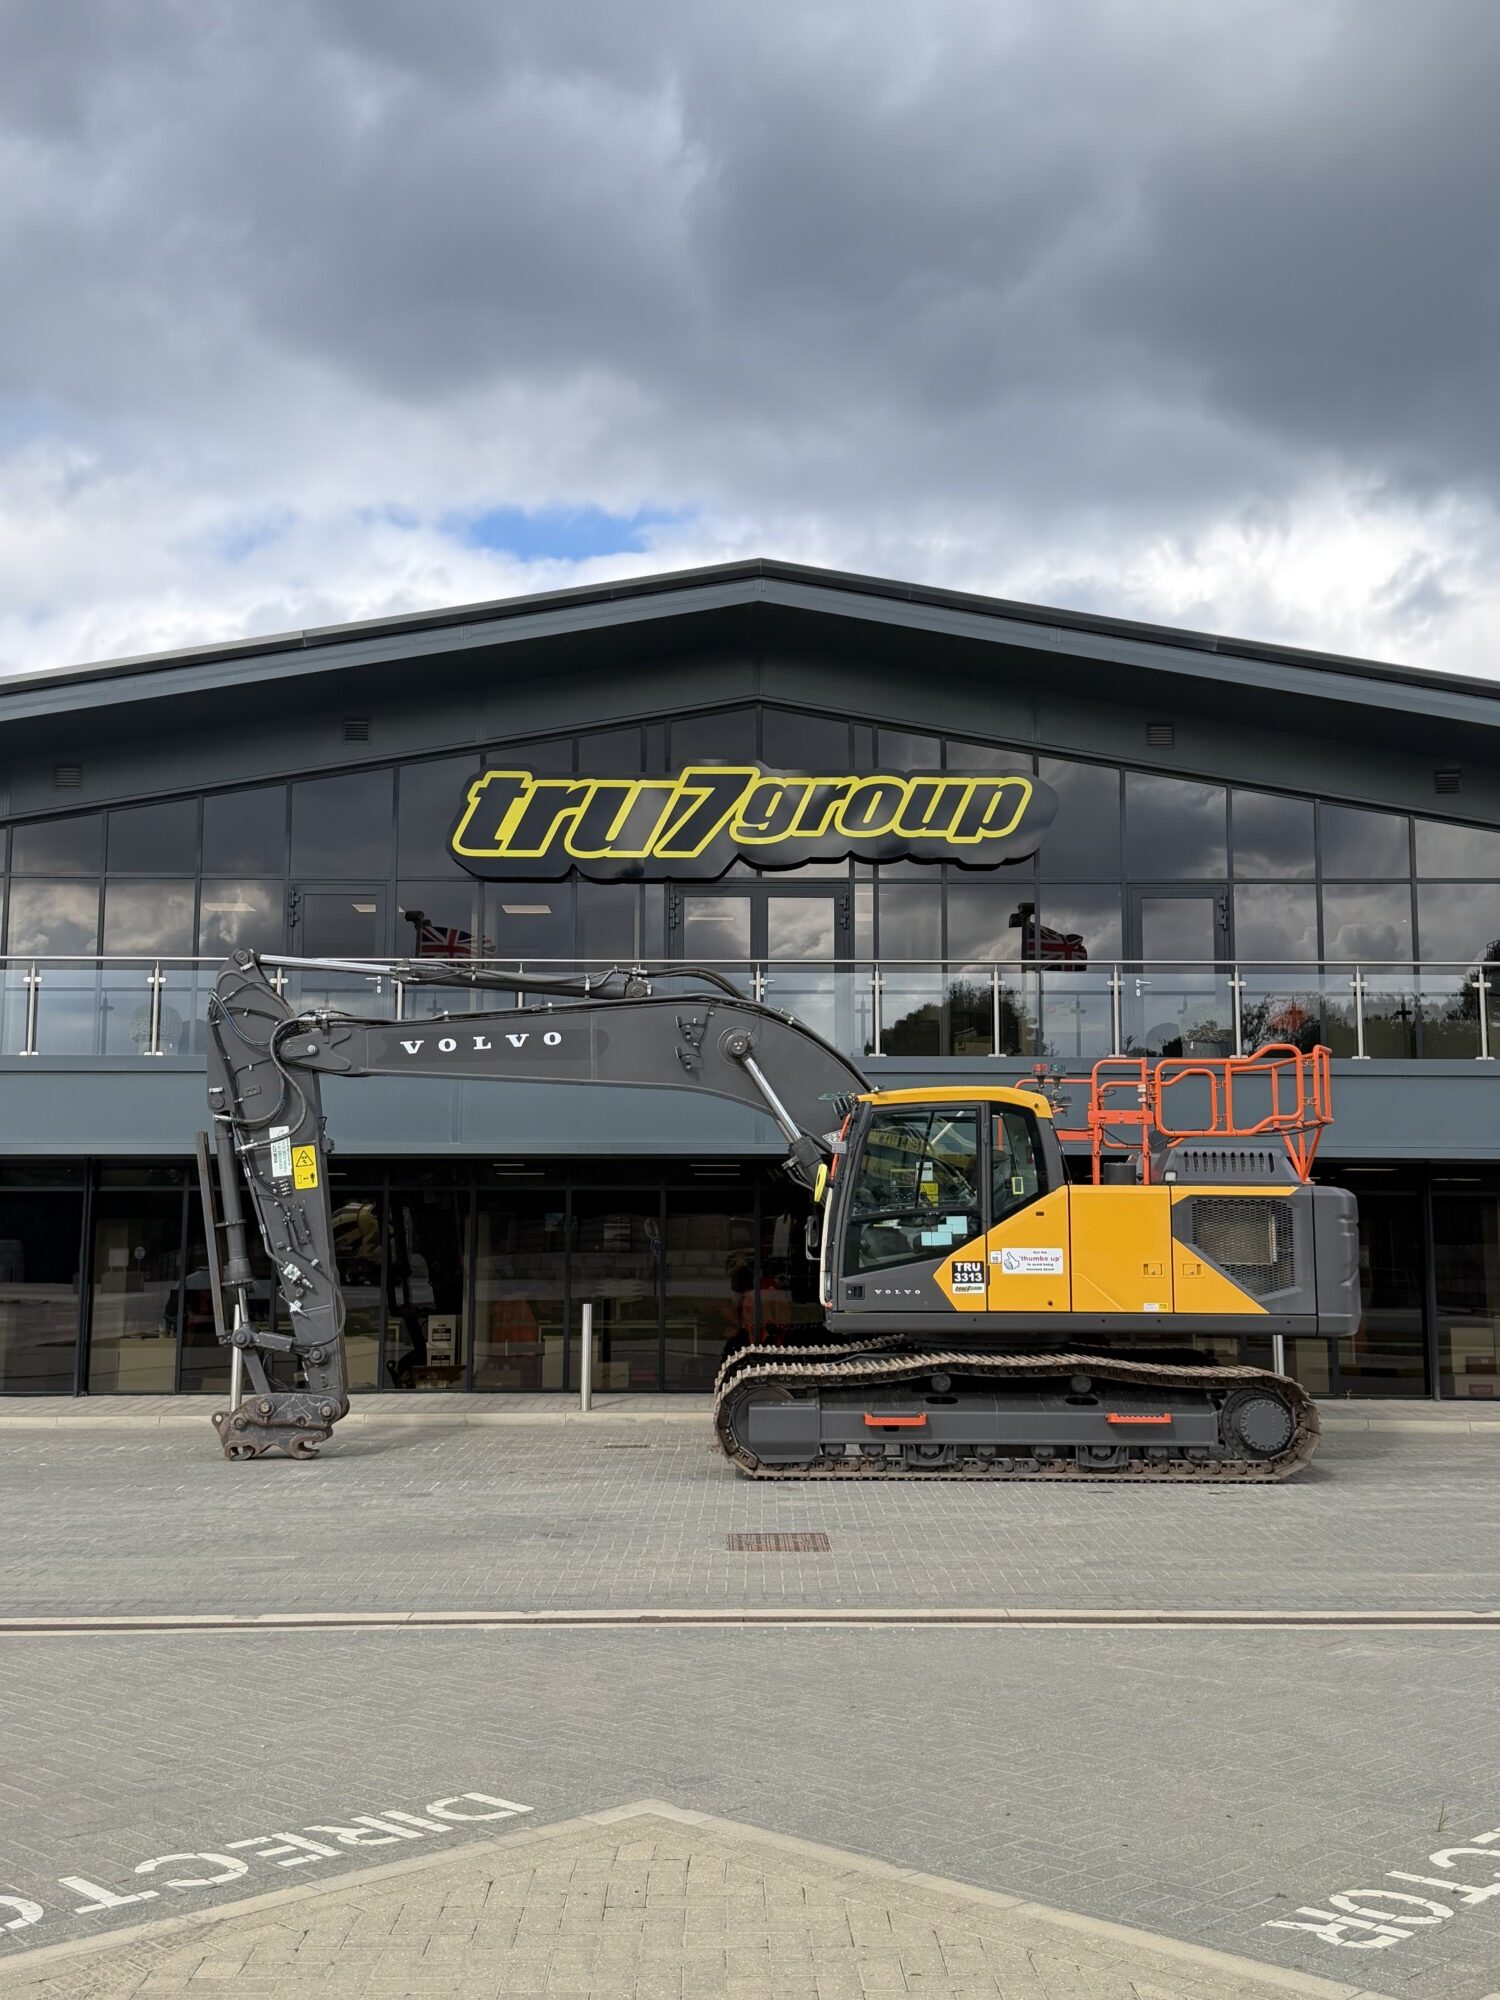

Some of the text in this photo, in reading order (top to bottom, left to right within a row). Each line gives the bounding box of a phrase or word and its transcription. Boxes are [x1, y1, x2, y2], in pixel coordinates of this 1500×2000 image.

[452, 767, 1034, 859] tru7group
[400, 1031, 562, 1054] VOLVO
[955, 1262, 981, 1271] TRU
[954, 1272, 982, 1282] 3313
